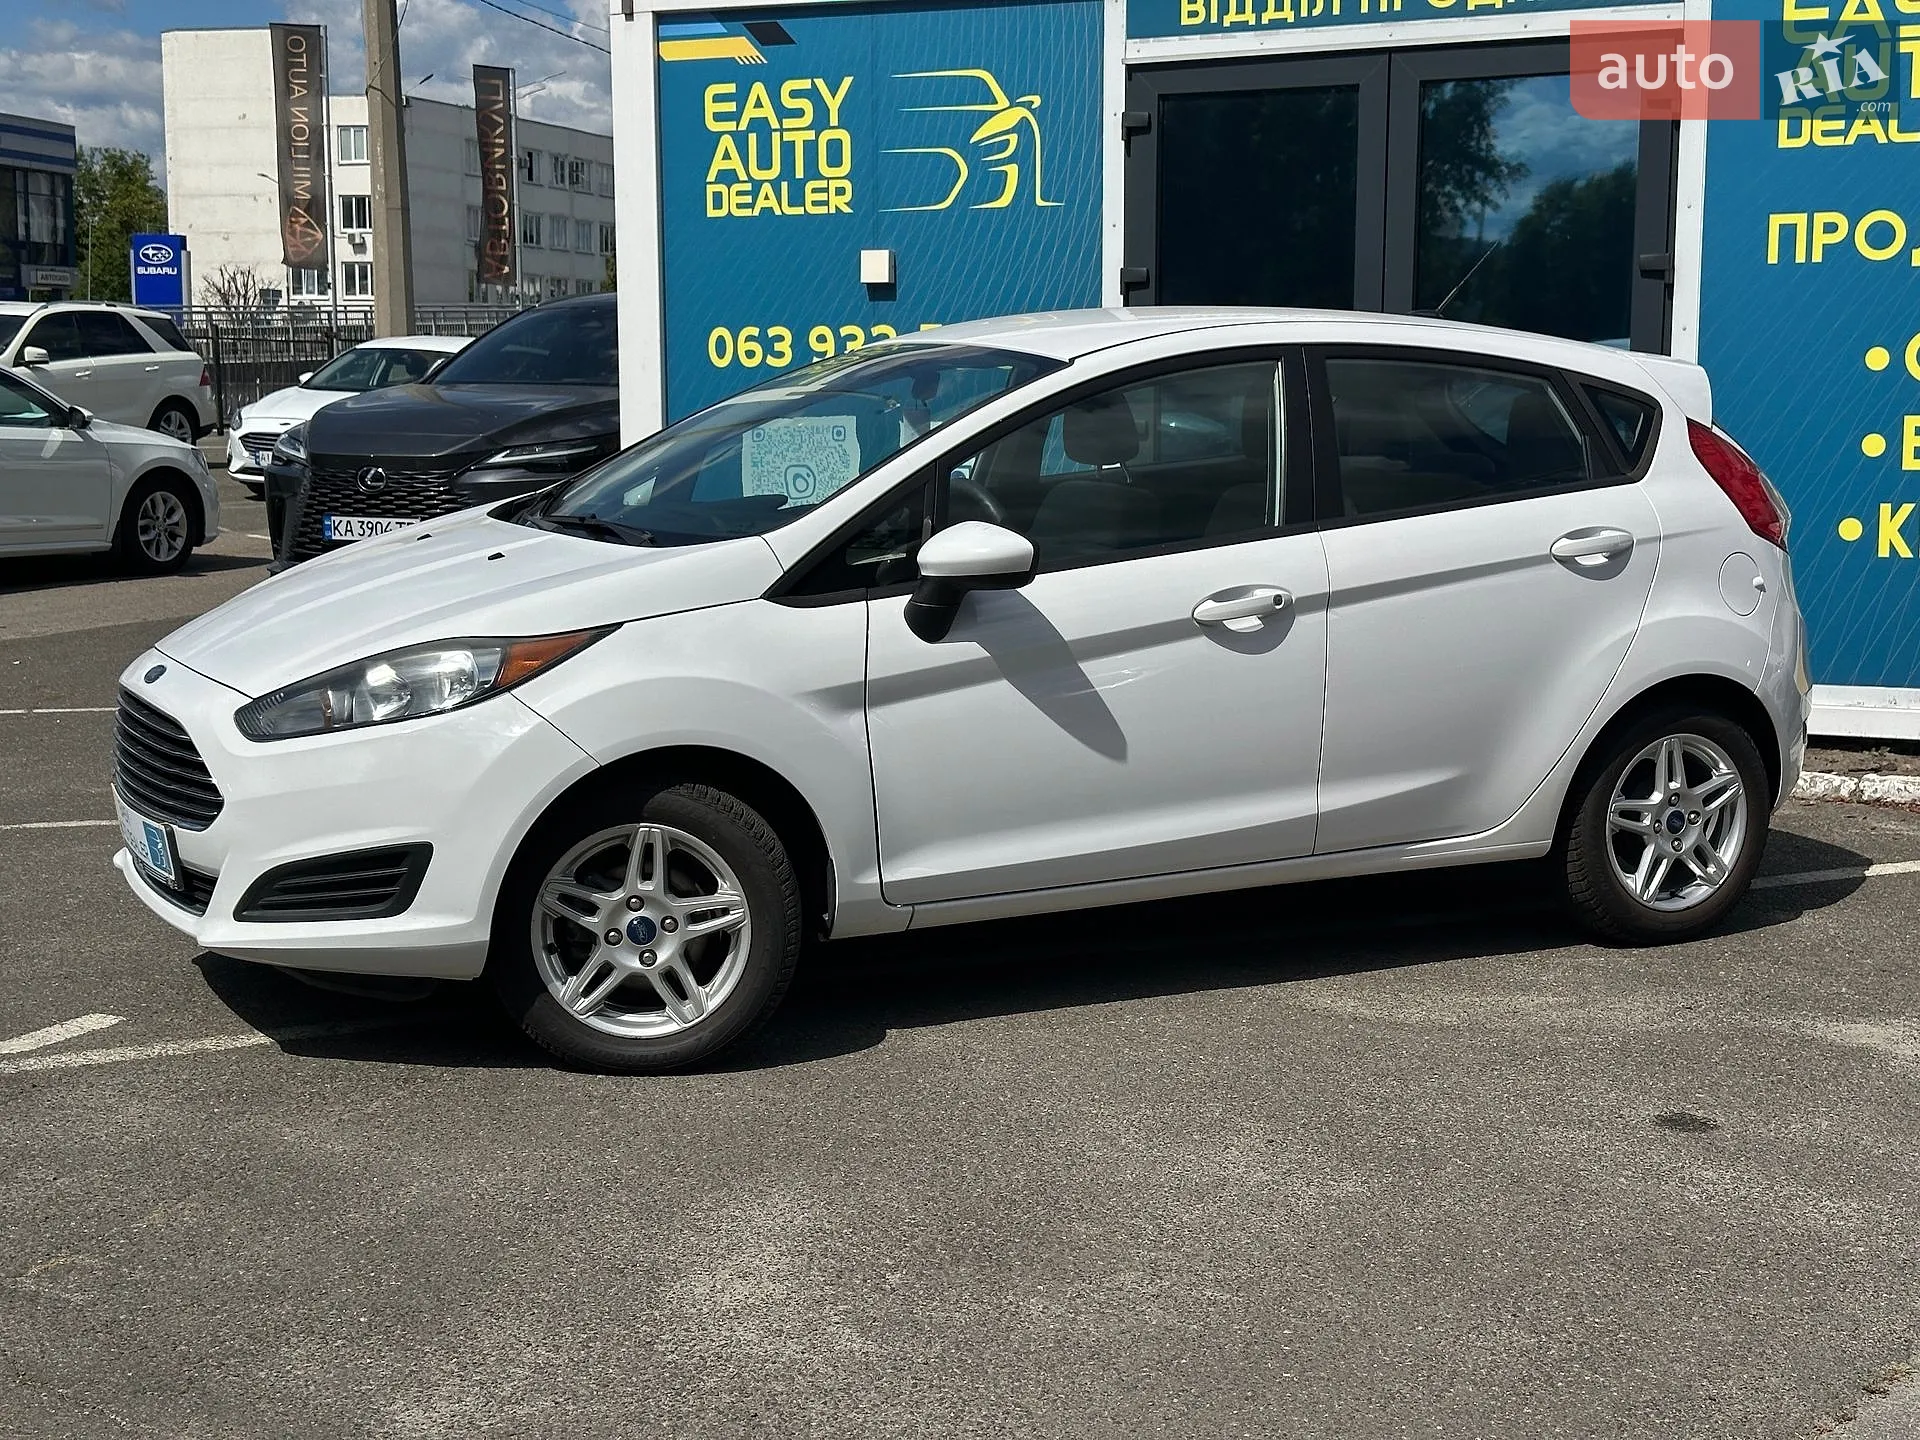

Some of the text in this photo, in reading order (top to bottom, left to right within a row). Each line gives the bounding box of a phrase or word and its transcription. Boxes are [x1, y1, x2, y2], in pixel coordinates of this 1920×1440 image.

[1782, 0, 1920, 44] EA
[704, 76, 855, 132] EASY
[706, 128, 852, 182] AUTO
[706, 179, 854, 218] DEALER
[1767, 209, 1920, 267] ПРО
[137, 267, 177, 275] SUBARU
[708, 326, 793, 368] 063
[333, 520, 354, 537] KA
